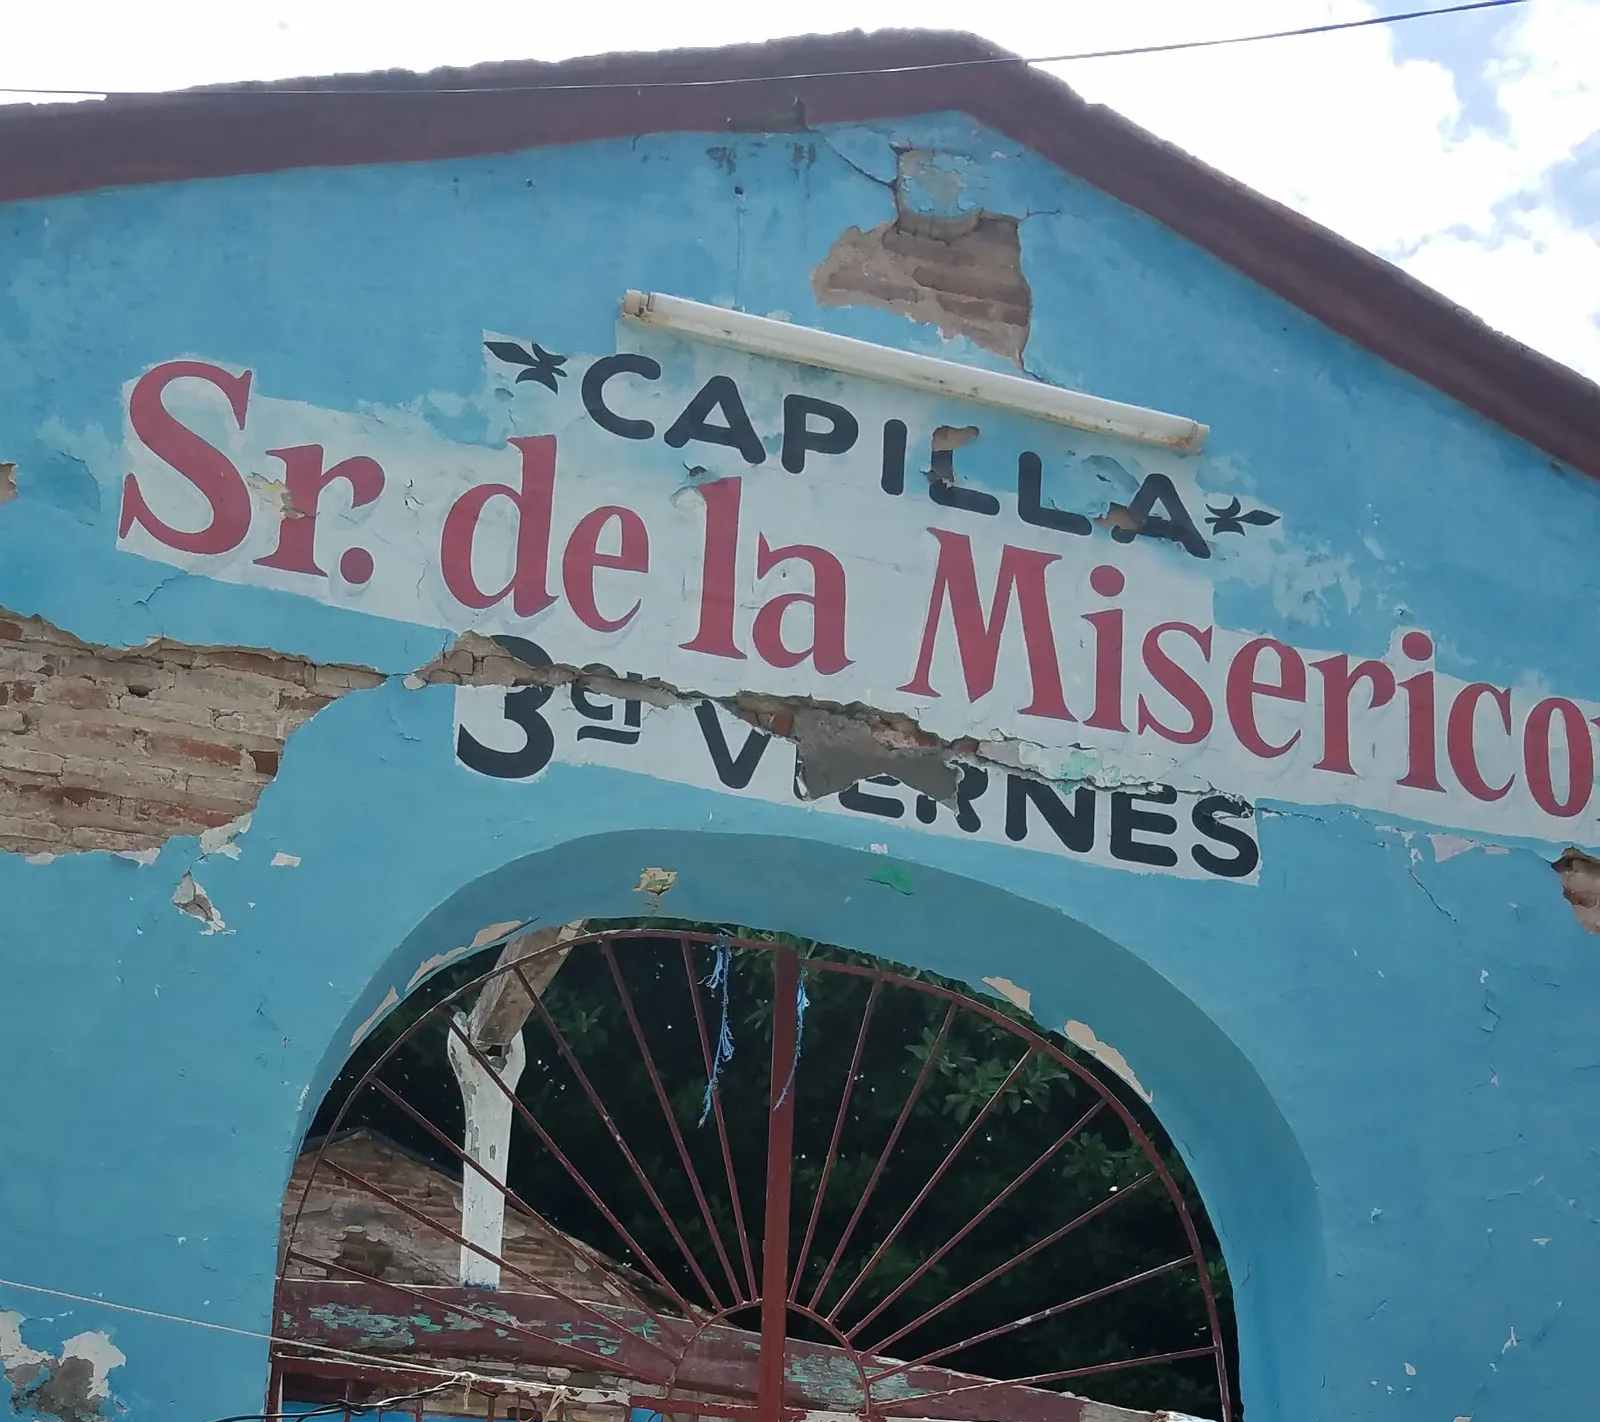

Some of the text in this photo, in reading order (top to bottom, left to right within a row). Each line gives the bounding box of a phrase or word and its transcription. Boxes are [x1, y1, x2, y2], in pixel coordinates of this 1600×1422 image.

[580, 353, 1211, 560] CAPILLA
[118, 360, 1600, 822] Sr. de la Miserico
[694, 699, 1260, 878] VERNES
